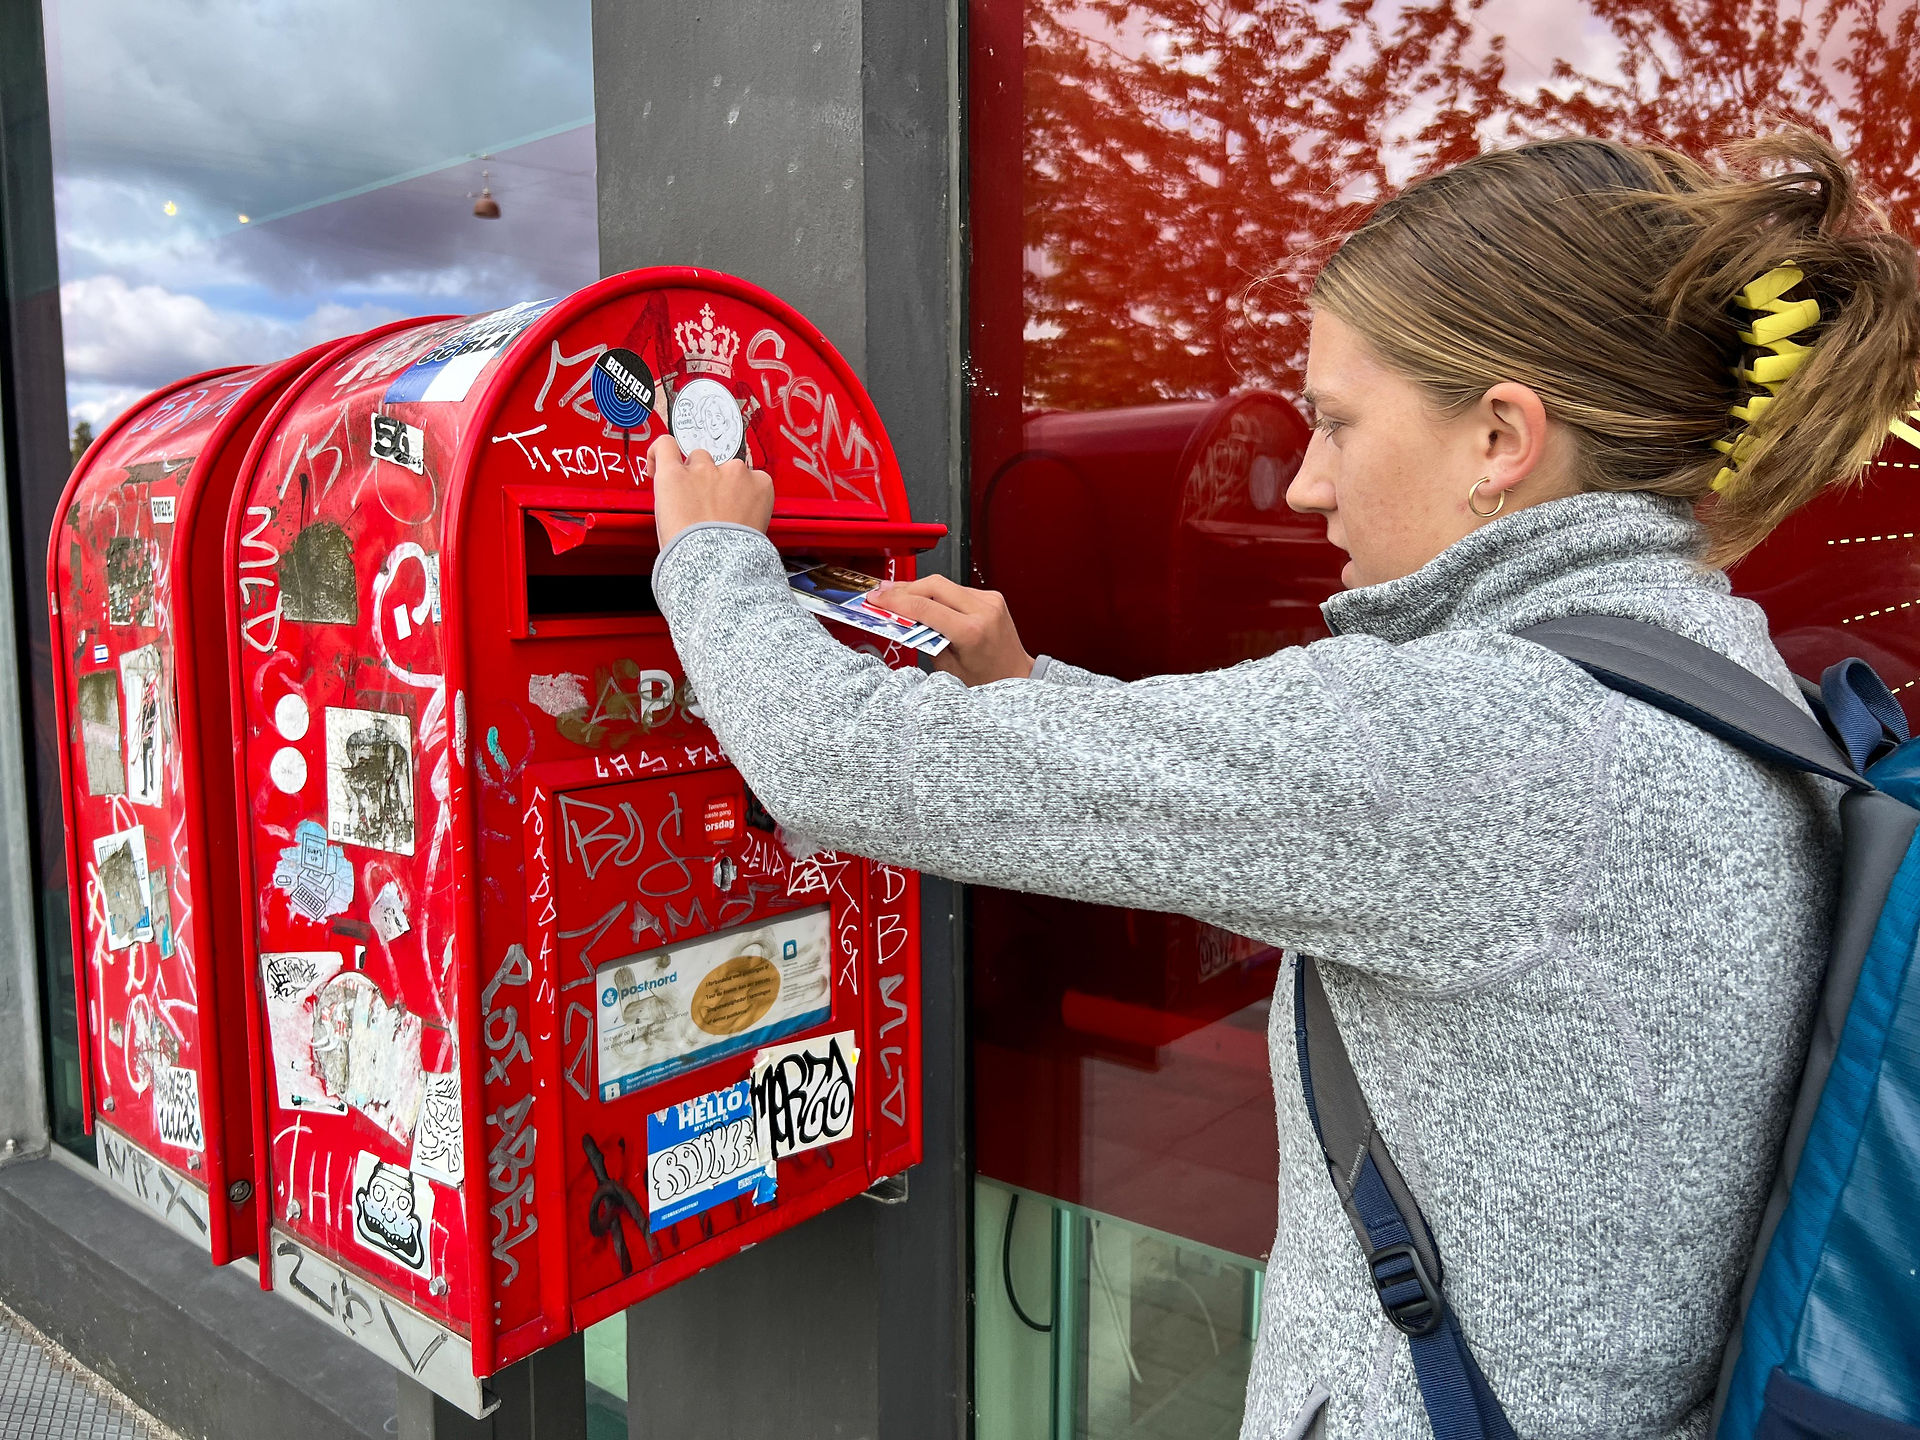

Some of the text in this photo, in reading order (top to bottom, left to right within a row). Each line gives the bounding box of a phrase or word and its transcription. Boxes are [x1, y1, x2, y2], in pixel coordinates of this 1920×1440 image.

[605, 356, 652, 404] BELLFIELD
[705, 818, 735, 832] orsdag
[719, 808, 732, 818] gang
[620, 971, 678, 1000] postnord
[678, 1089, 743, 1131] HELLO
